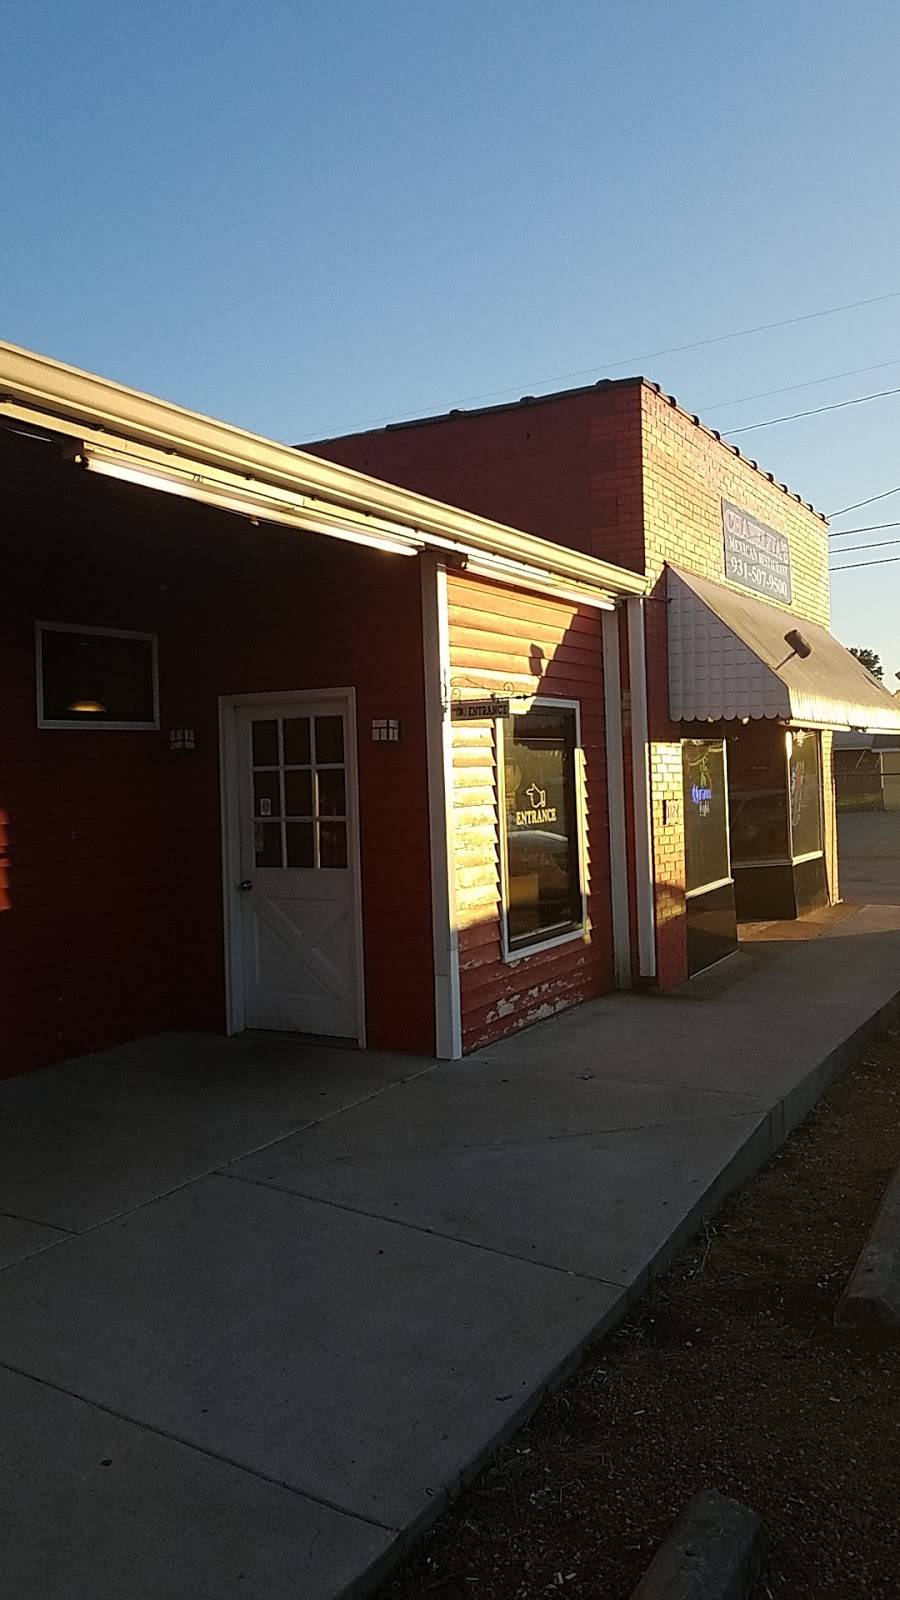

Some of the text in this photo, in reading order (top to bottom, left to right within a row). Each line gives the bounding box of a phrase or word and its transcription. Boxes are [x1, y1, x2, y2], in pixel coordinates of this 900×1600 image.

[727, 535, 758, 561] MEXICAN
[758, 552, 788, 578] RESTAURANT
[731, 556, 788, 597] 931-507-9500
[468, 704, 508, 716] ENTRANCE
[516, 808, 557, 826] ENTRANCE
